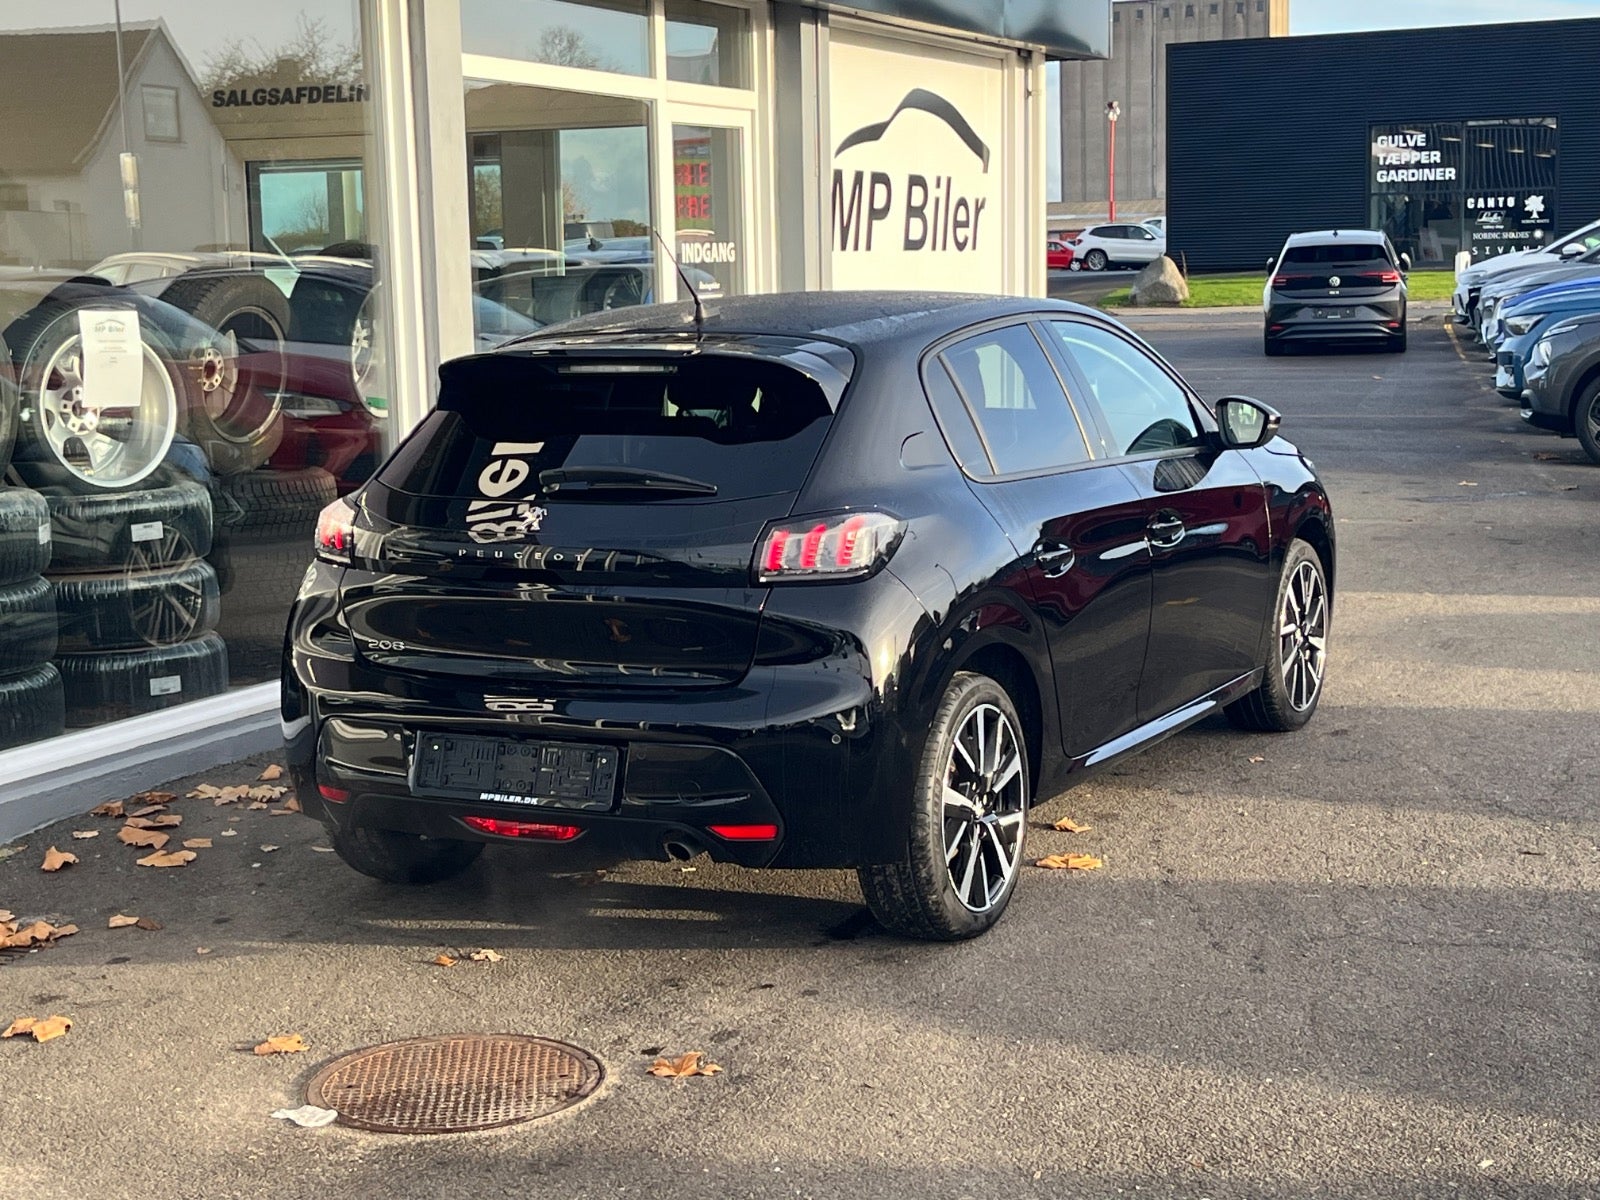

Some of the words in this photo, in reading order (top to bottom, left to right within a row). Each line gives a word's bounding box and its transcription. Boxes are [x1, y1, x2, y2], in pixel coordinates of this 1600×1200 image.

[1377, 134, 1426, 147] GULVE
[1377, 150, 1441, 165] TÆPPER
[1376, 167, 1456, 183] GARDINER
[832, 168, 892, 252] MP
[903, 174, 987, 252] Biler
[681, 242, 735, 263] INDGANG
[458, 549, 583, 562] PEUGEOT
[368, 639, 405, 651] 208
[480, 792, 539, 805] MPBILER.DK
